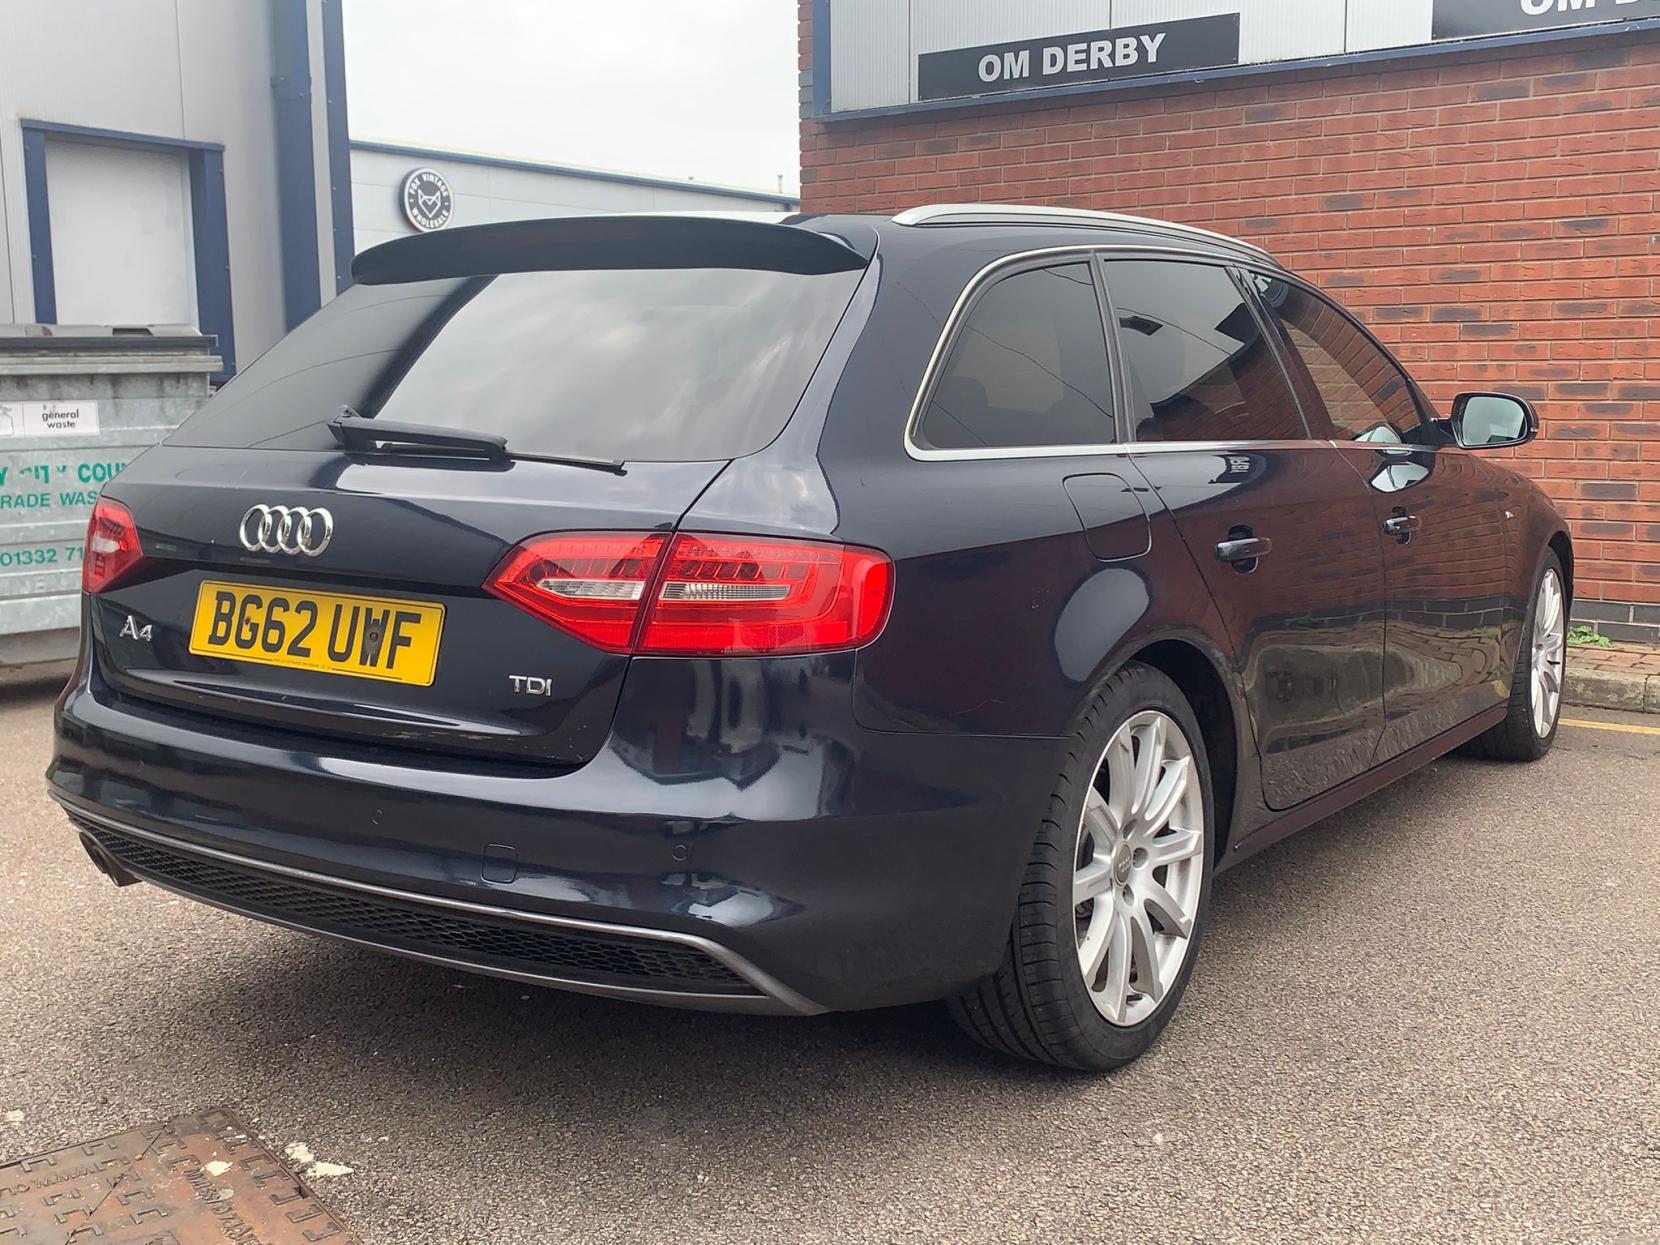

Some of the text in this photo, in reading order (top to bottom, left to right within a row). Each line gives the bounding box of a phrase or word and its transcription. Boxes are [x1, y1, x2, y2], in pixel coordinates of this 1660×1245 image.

[977, 33, 1167, 83] OM DERBY
[41, 409, 80, 421] general
[46, 420, 77, 429] waste
[0, 547, 58, 567] 01332
[119, 615, 153, 642] A4
[207, 591, 422, 669] BG62 UWF
[509, 675, 552, 697] TDI
